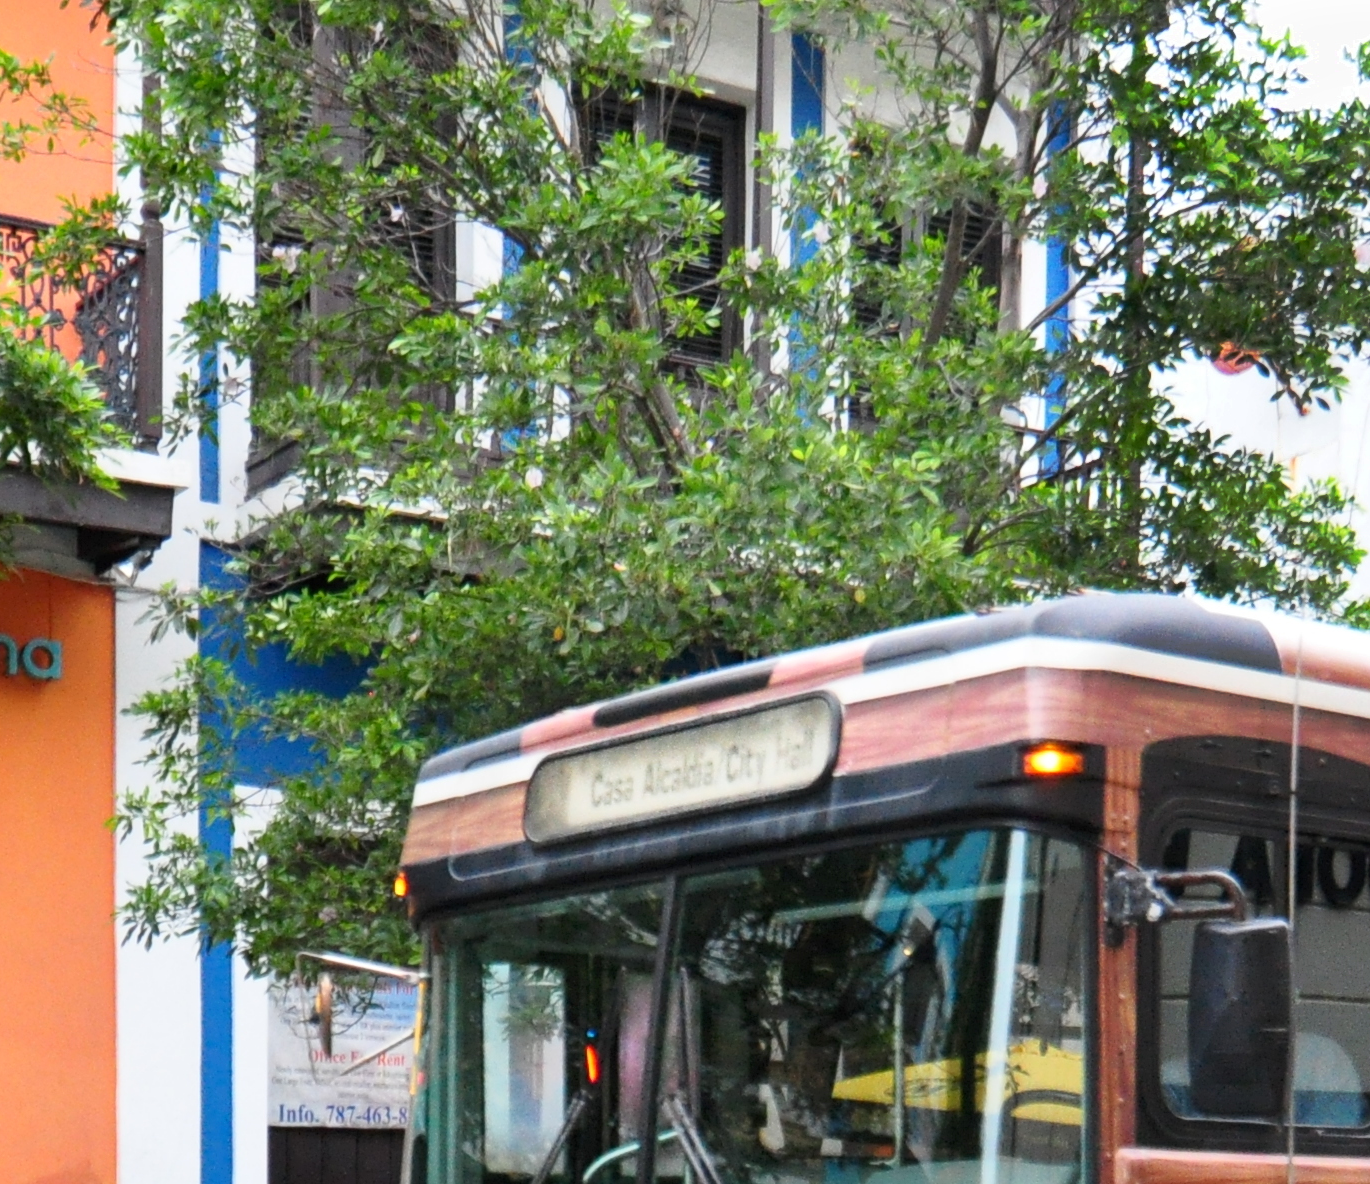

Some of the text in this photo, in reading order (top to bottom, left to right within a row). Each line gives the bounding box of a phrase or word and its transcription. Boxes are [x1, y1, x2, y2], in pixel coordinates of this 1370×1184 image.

[590, 769, 634, 808] Casa
[725, 744, 767, 785] City
[310, 1050, 346, 1064] Offce
[377, 1051, 406, 1066] Rent
[278, 1103, 320, 1123] Info.
